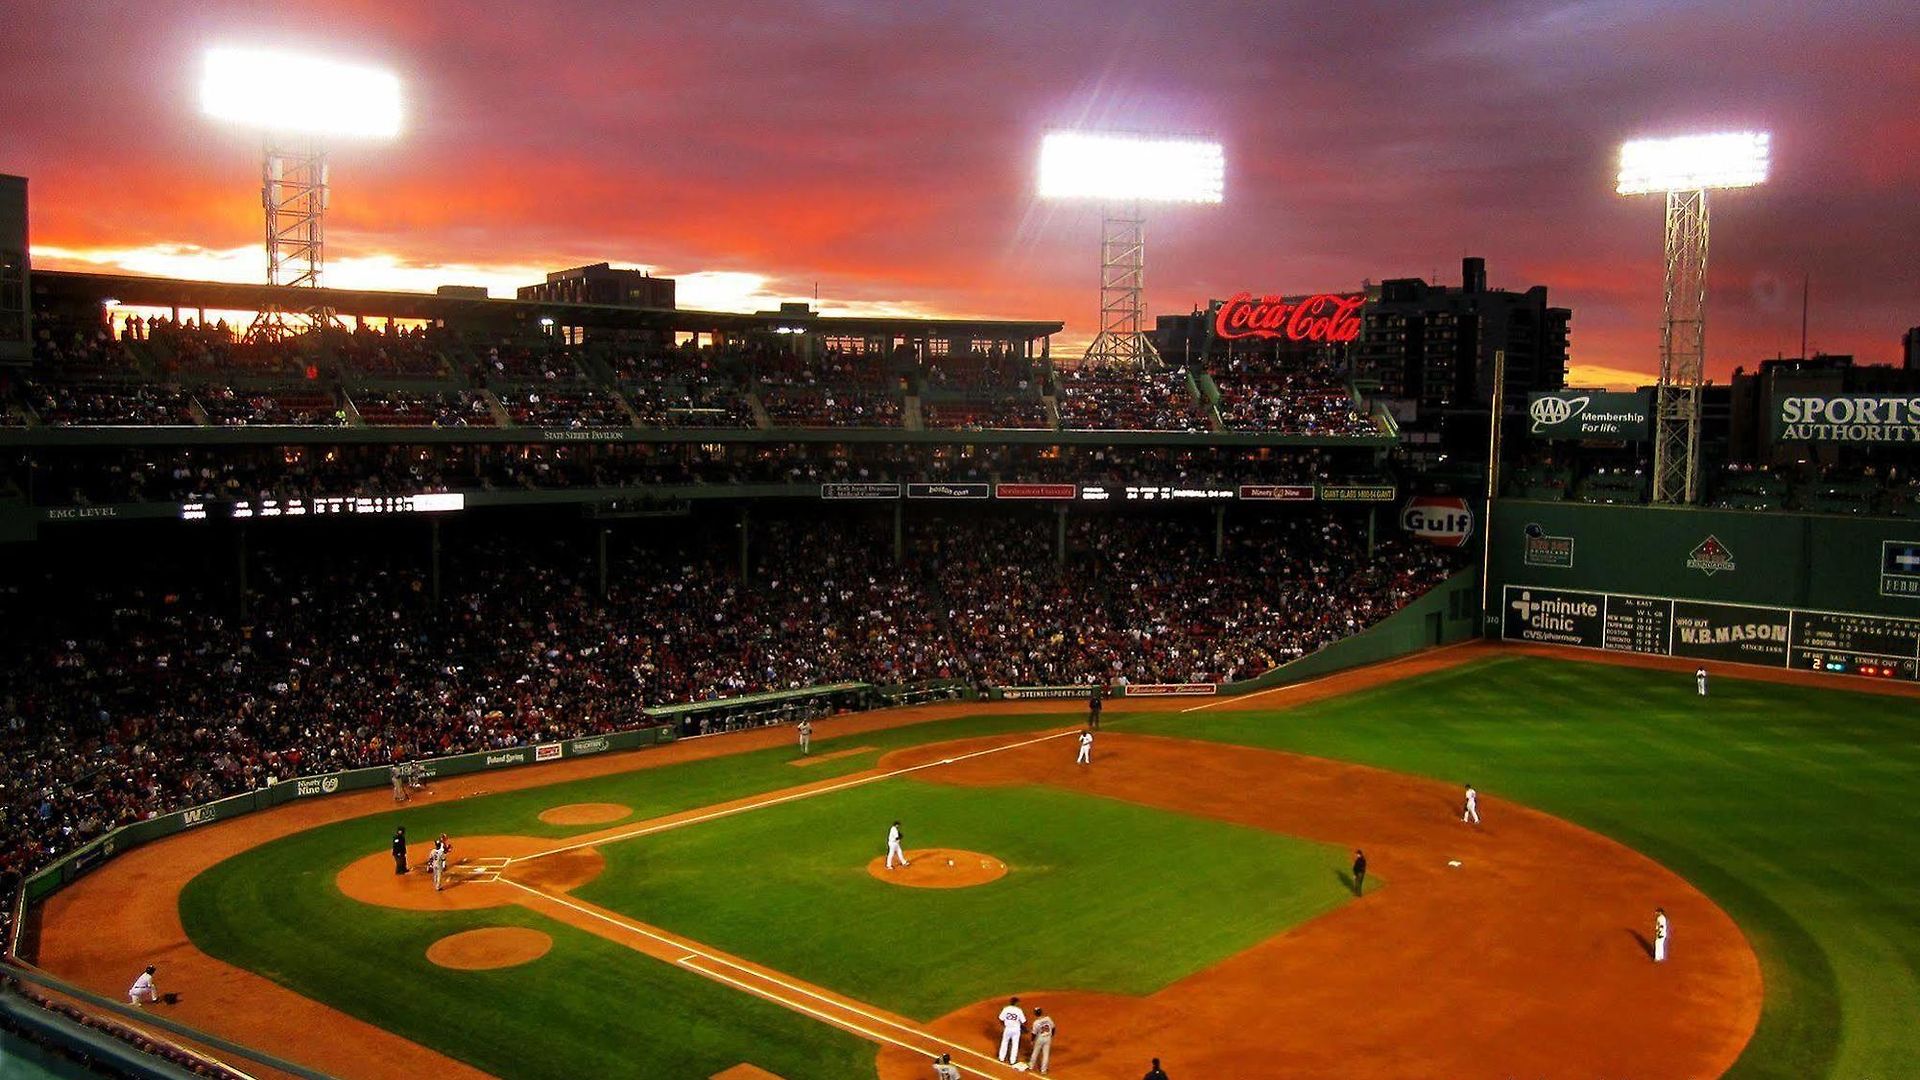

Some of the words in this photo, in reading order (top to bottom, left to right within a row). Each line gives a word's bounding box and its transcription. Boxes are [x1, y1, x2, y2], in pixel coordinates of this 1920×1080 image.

[1533, 398, 1567, 422] AAA
[1782, 397, 1920, 424] SPORTS
[1581, 412, 1644, 423] Membership
[1581, 423, 1600, 432] For
[1782, 424, 1920, 441] AUTHORITY
[566, 431, 589, 440] STREET
[592, 431, 624, 440] PAVILION
[929, 485, 968, 496] boston.com
[50, 508, 76, 519] EMC
[80, 507, 116, 517] LEVEL
[1405, 510, 1469, 532] Gulf
[1541, 597, 1598, 618] minute
[1532, 614, 1574, 632] clinic
[1676, 617, 1693, 627] WHO
[1694, 618, 1709, 628] BUT
[1823, 616, 1874, 626] FENWAY
[1523, 630, 1583, 644] CVS/pharmacy
[1812, 638, 1836, 647] BOSTON
[1813, 658, 1820, 670] 2
[1829, 654, 1846, 662] BALL
[1855, 657, 1878, 665] STRIKE
[506, 754, 524, 764] Spring
[298, 780, 321, 788] Ninety
[298, 786, 320, 795] Nine
